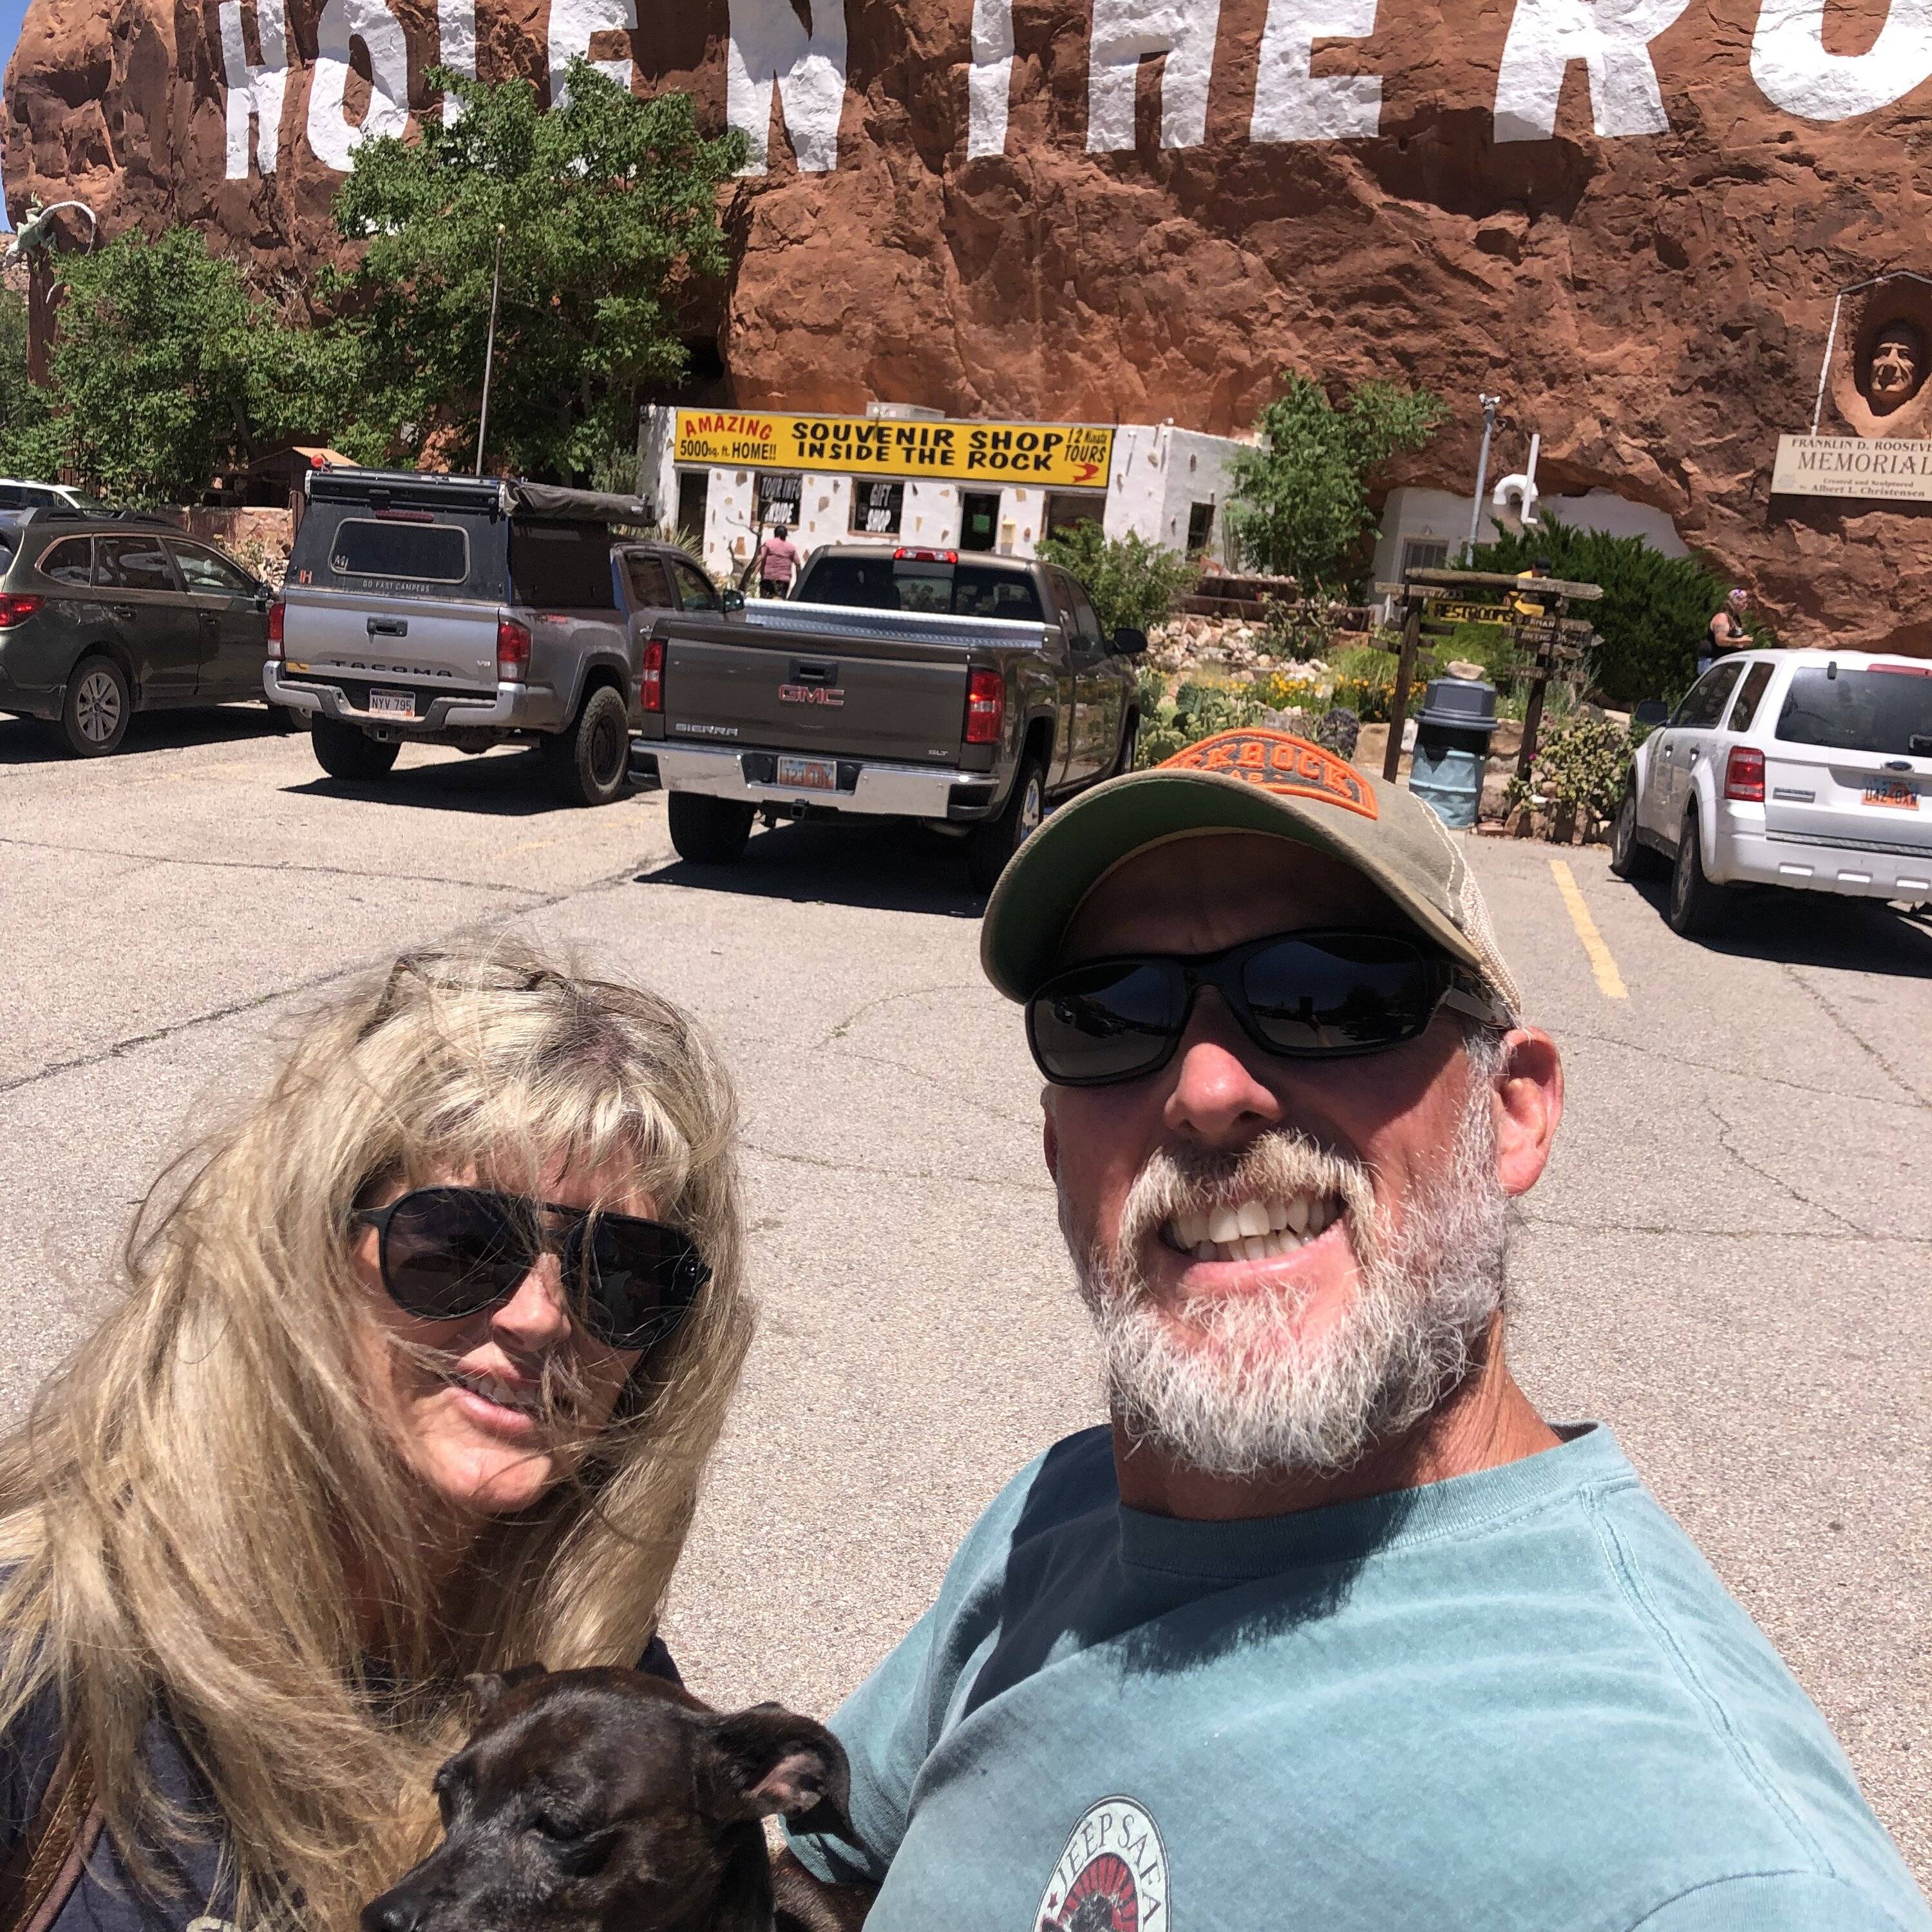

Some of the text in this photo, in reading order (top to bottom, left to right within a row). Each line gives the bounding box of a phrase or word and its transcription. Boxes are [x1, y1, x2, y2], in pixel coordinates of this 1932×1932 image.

[685, 414, 773, 440] AMAZING
[1068, 428, 1083, 444] 12
[791, 422, 1063, 452] SOUVENIR SHOP
[1792, 439, 1853, 450] FRANKLIN
[1857, 441, 1869, 450] D.
[732, 442, 777, 461] HOME!!
[797, 442, 1054, 471] INSIDE THE ROCK
[1064, 444, 1106, 463] TOURS
[1797, 451, 1932, 475] MEMORIAL
[375, 581, 393, 589] FAST
[330, 659, 453, 677] TACOMA
[372, 697, 412, 712] NYV 795
[777, 684, 846, 706] GMC
[676, 723, 739, 736] SIERRA
